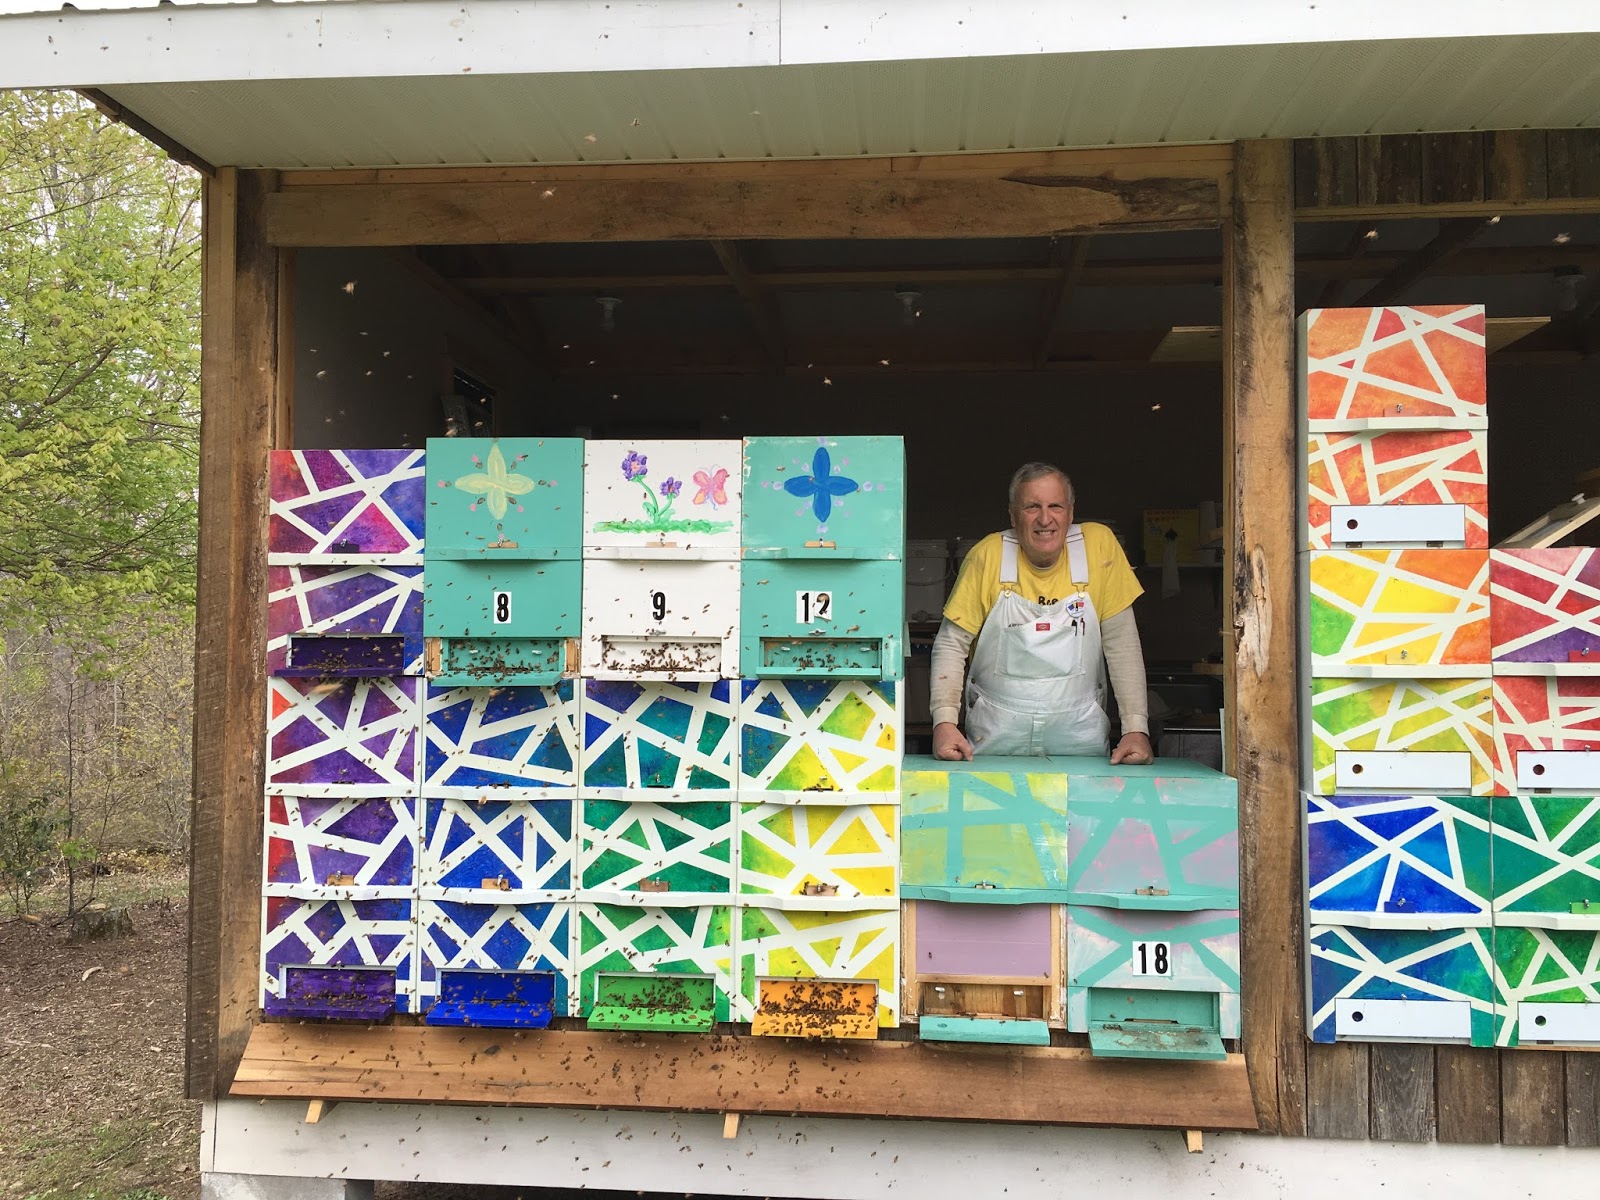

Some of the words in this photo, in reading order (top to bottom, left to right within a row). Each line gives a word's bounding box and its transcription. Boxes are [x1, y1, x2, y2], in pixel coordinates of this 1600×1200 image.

[497, 593, 509, 622] 8
[653, 592, 665, 621] 9
[802, 593, 830, 621] 12
[1138, 943, 1168, 974] 18
